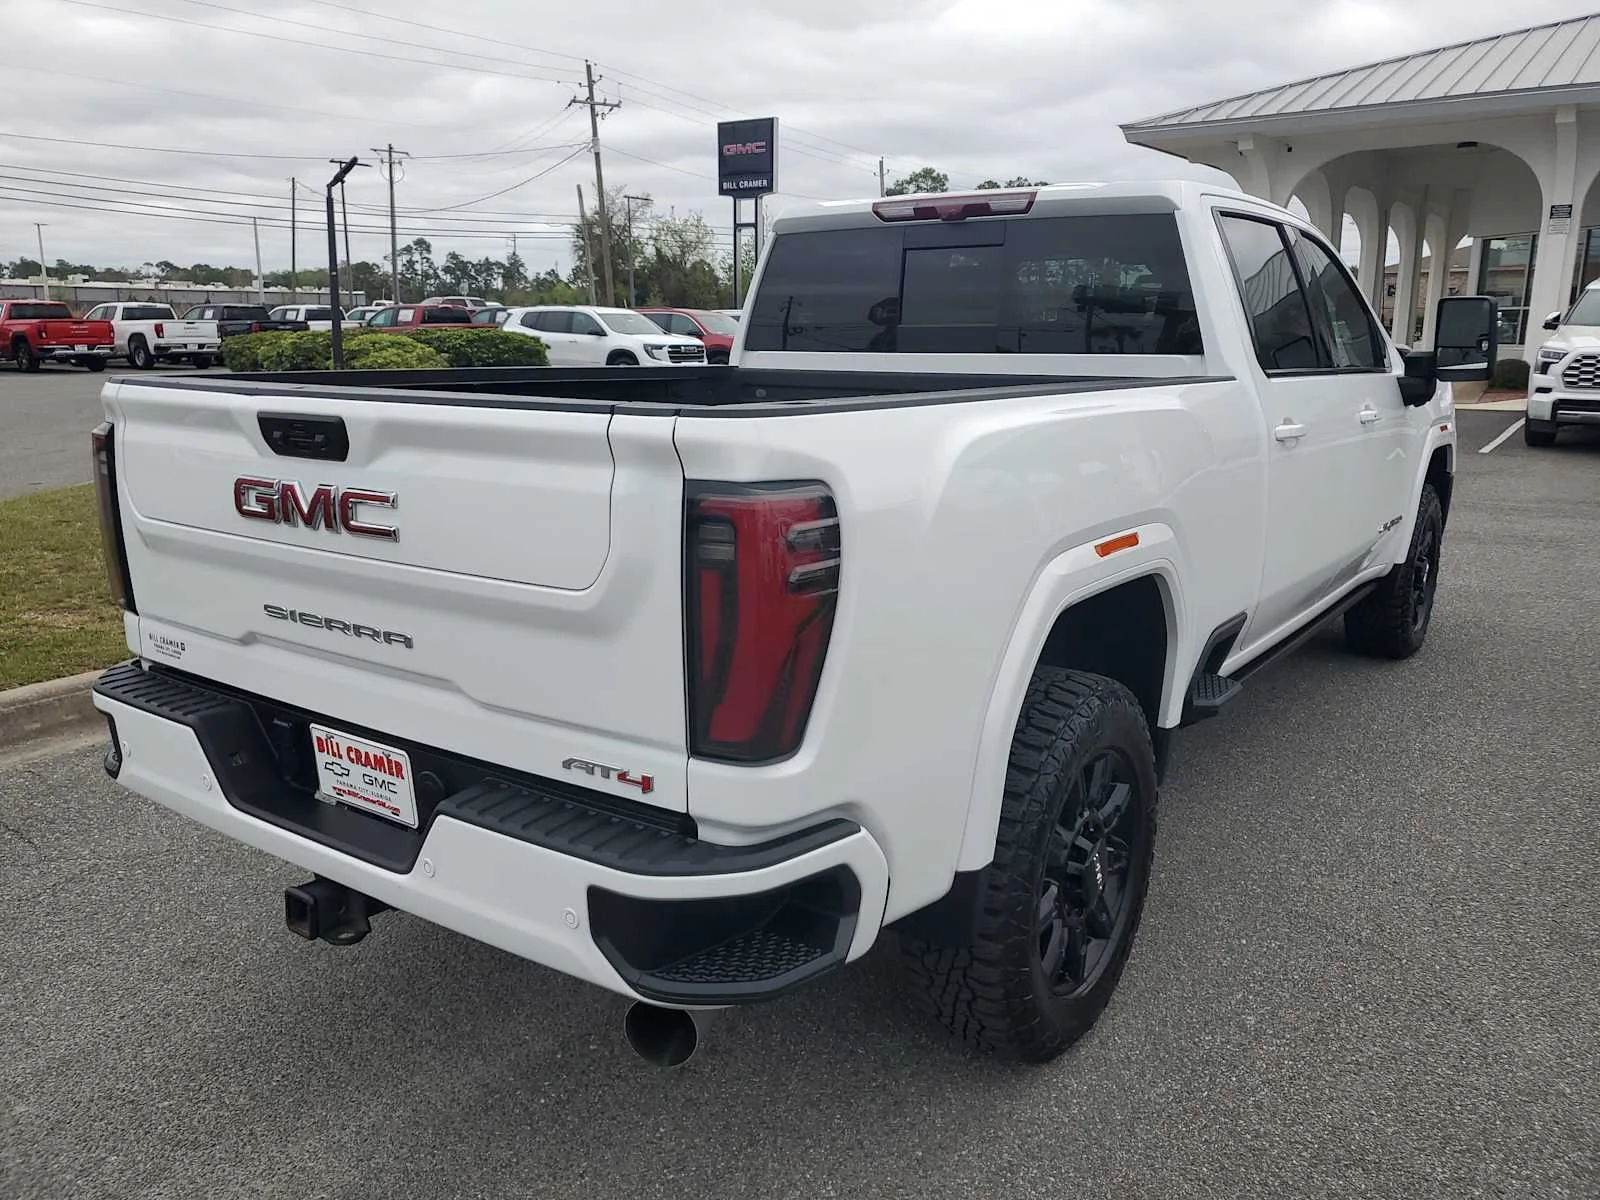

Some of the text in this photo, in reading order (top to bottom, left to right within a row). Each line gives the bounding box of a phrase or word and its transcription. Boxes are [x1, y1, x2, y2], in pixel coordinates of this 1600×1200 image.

[723, 142, 766, 156] GMC
[722, 180, 768, 190] BILL CRAMER
[234, 474, 400, 543] GMC
[263, 603, 414, 649] SIERRA
[315, 735, 405, 781] BILL CRAMER
[562, 757, 655, 794] AT4
[362, 773, 398, 794] GMC
